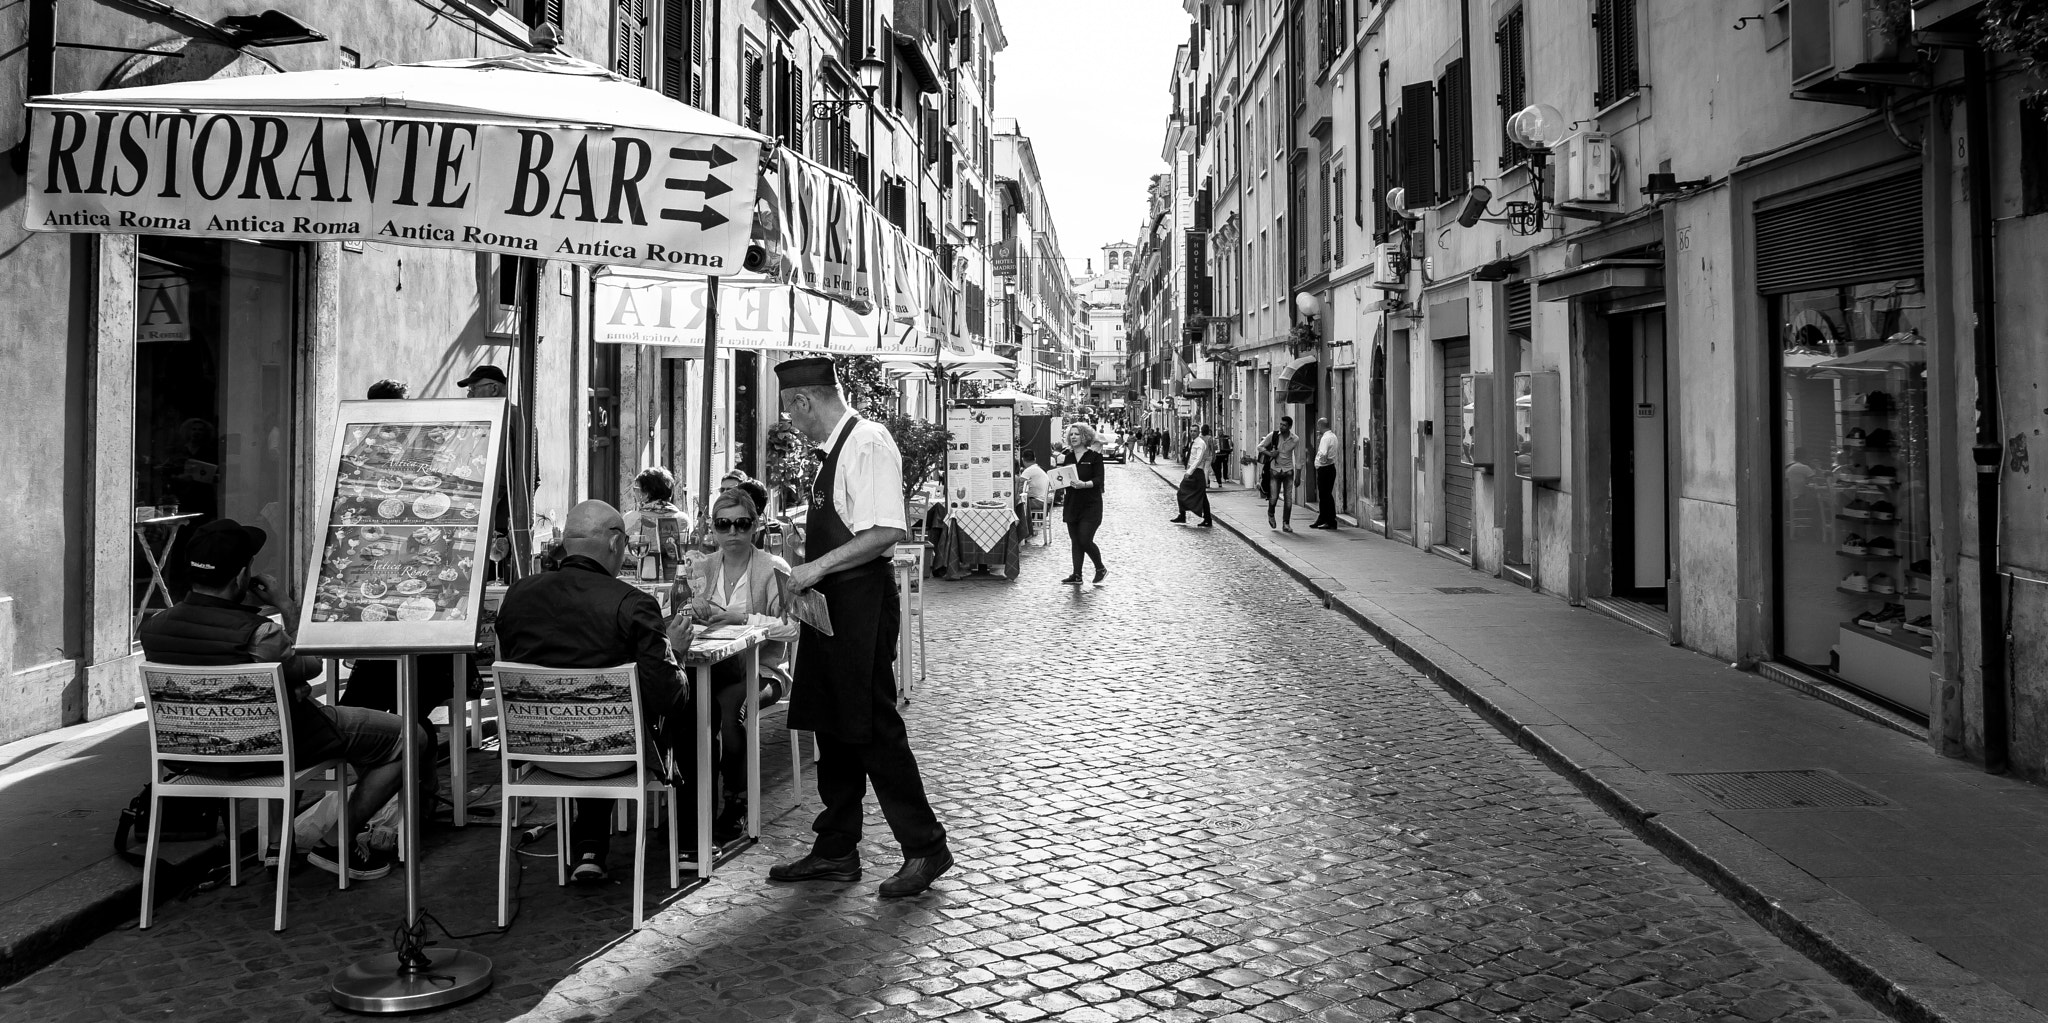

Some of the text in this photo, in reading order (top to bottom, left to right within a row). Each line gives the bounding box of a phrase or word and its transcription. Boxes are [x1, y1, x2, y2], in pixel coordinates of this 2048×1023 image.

[44, 110, 652, 227] RISTORANTE BAR
[44, 209, 724, 269] Antica Roma Antica Roma Antica Roma Antica Roma
[1678, 230, 1691, 251] 86
[382, 457, 417, 468] Antica
[364, 560, 402, 571] Antica
[402, 566, 430, 578] Roma
